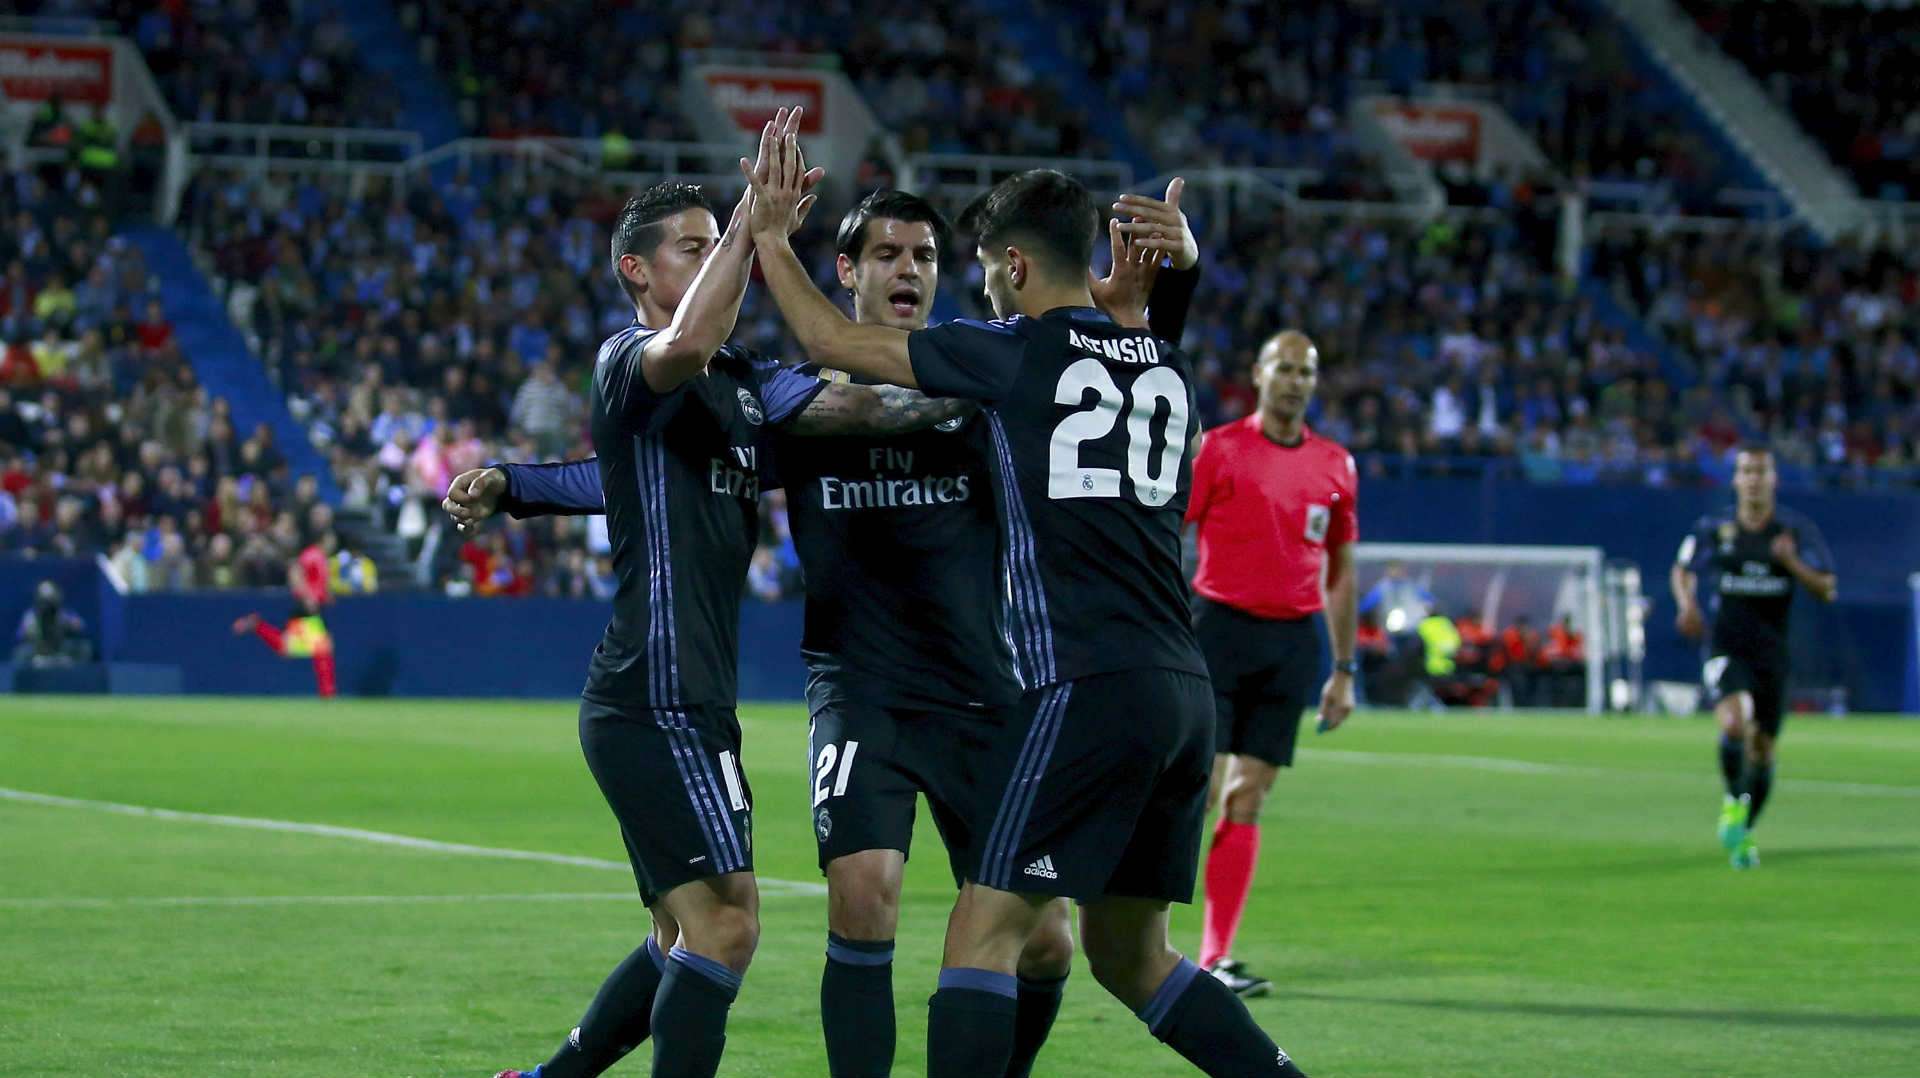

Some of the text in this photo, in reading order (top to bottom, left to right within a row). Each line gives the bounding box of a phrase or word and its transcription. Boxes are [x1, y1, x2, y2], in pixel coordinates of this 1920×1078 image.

[869, 448, 913, 473] Fly
[1048, 358, 1189, 507] 20
[820, 473, 969, 510] Emirates
[719, 750, 750, 812] 1
[814, 740, 859, 808] 21
